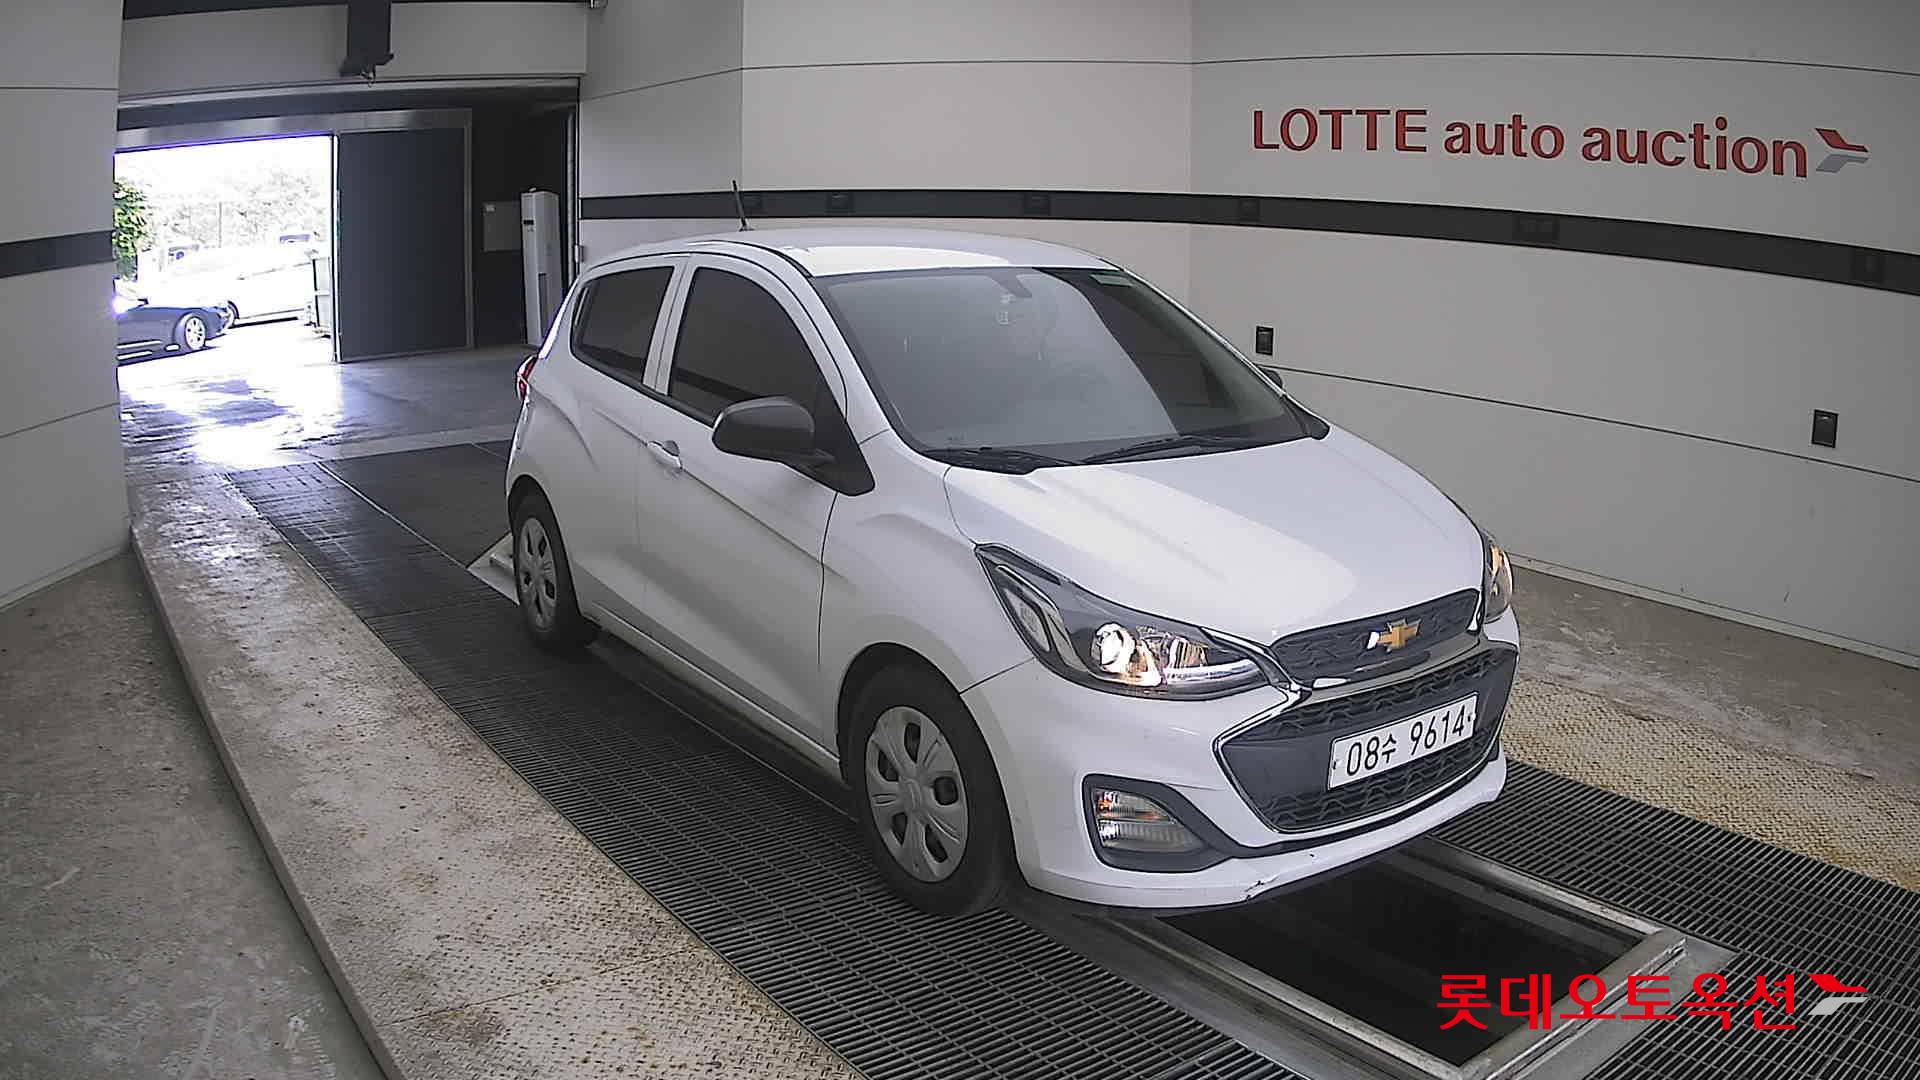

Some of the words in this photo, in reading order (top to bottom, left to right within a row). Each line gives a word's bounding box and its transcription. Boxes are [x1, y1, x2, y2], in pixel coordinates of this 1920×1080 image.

[1252, 108, 1428, 152] LOTTE
[1443, 114, 1566, 159] auto
[1581, 116, 1809, 178] auction
[1346, 733, 1397, 776] 08수
[1410, 704, 1466, 756] 9614
